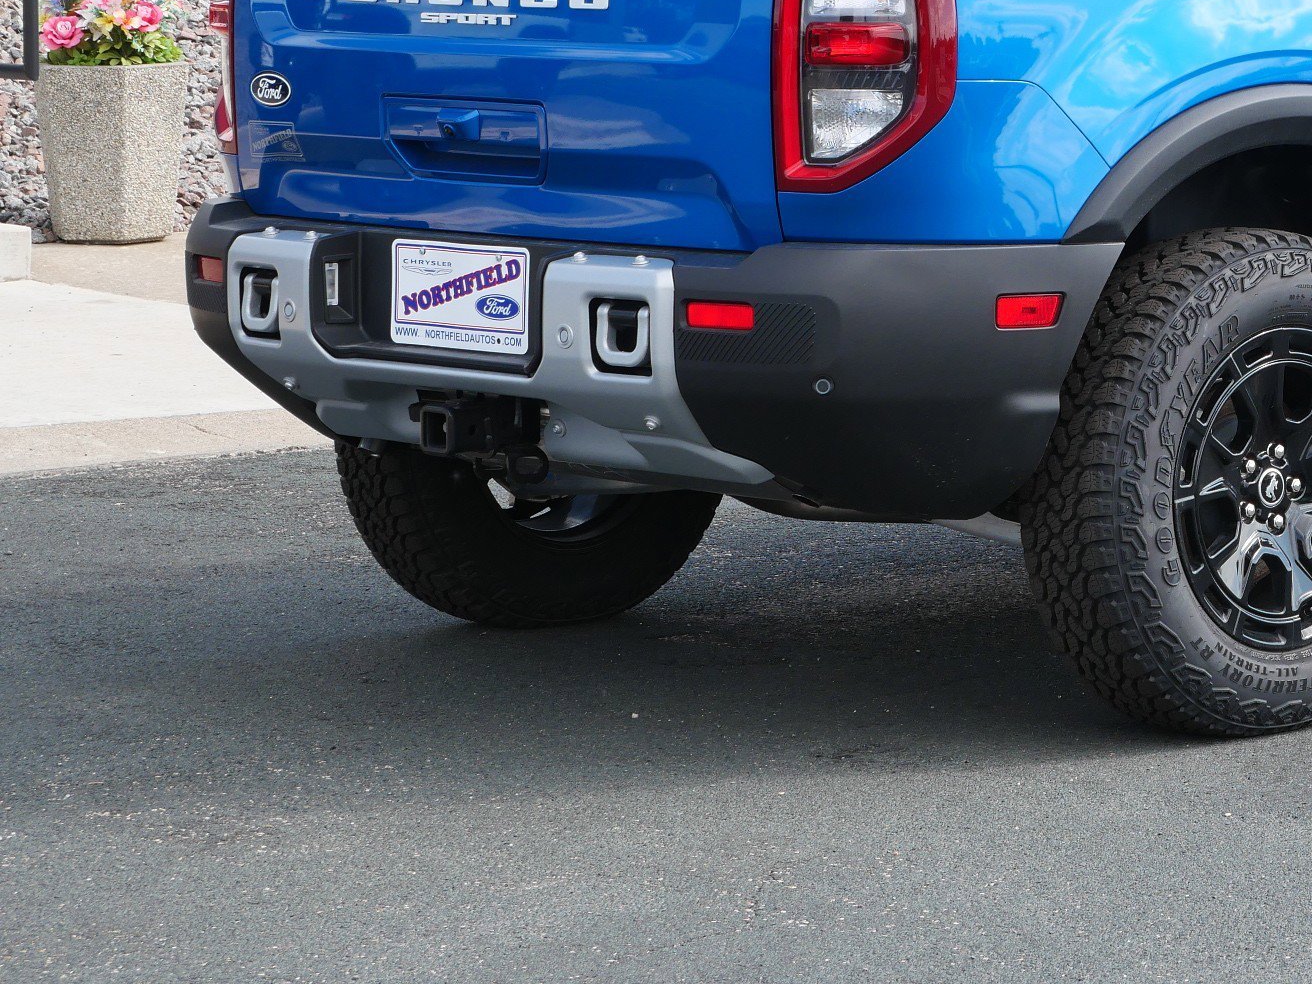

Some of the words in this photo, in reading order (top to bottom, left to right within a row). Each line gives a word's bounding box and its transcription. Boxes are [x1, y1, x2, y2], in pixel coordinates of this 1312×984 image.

[420, 11, 517, 26] SPORT
[257, 78, 283, 100] Ford
[402, 258, 452, 267] CHRYSLER
[401, 259, 521, 315] NORTHFIELD
[483, 297, 511, 316] Ford
[1214, 641, 1299, 678] ALL-TERRAIN
